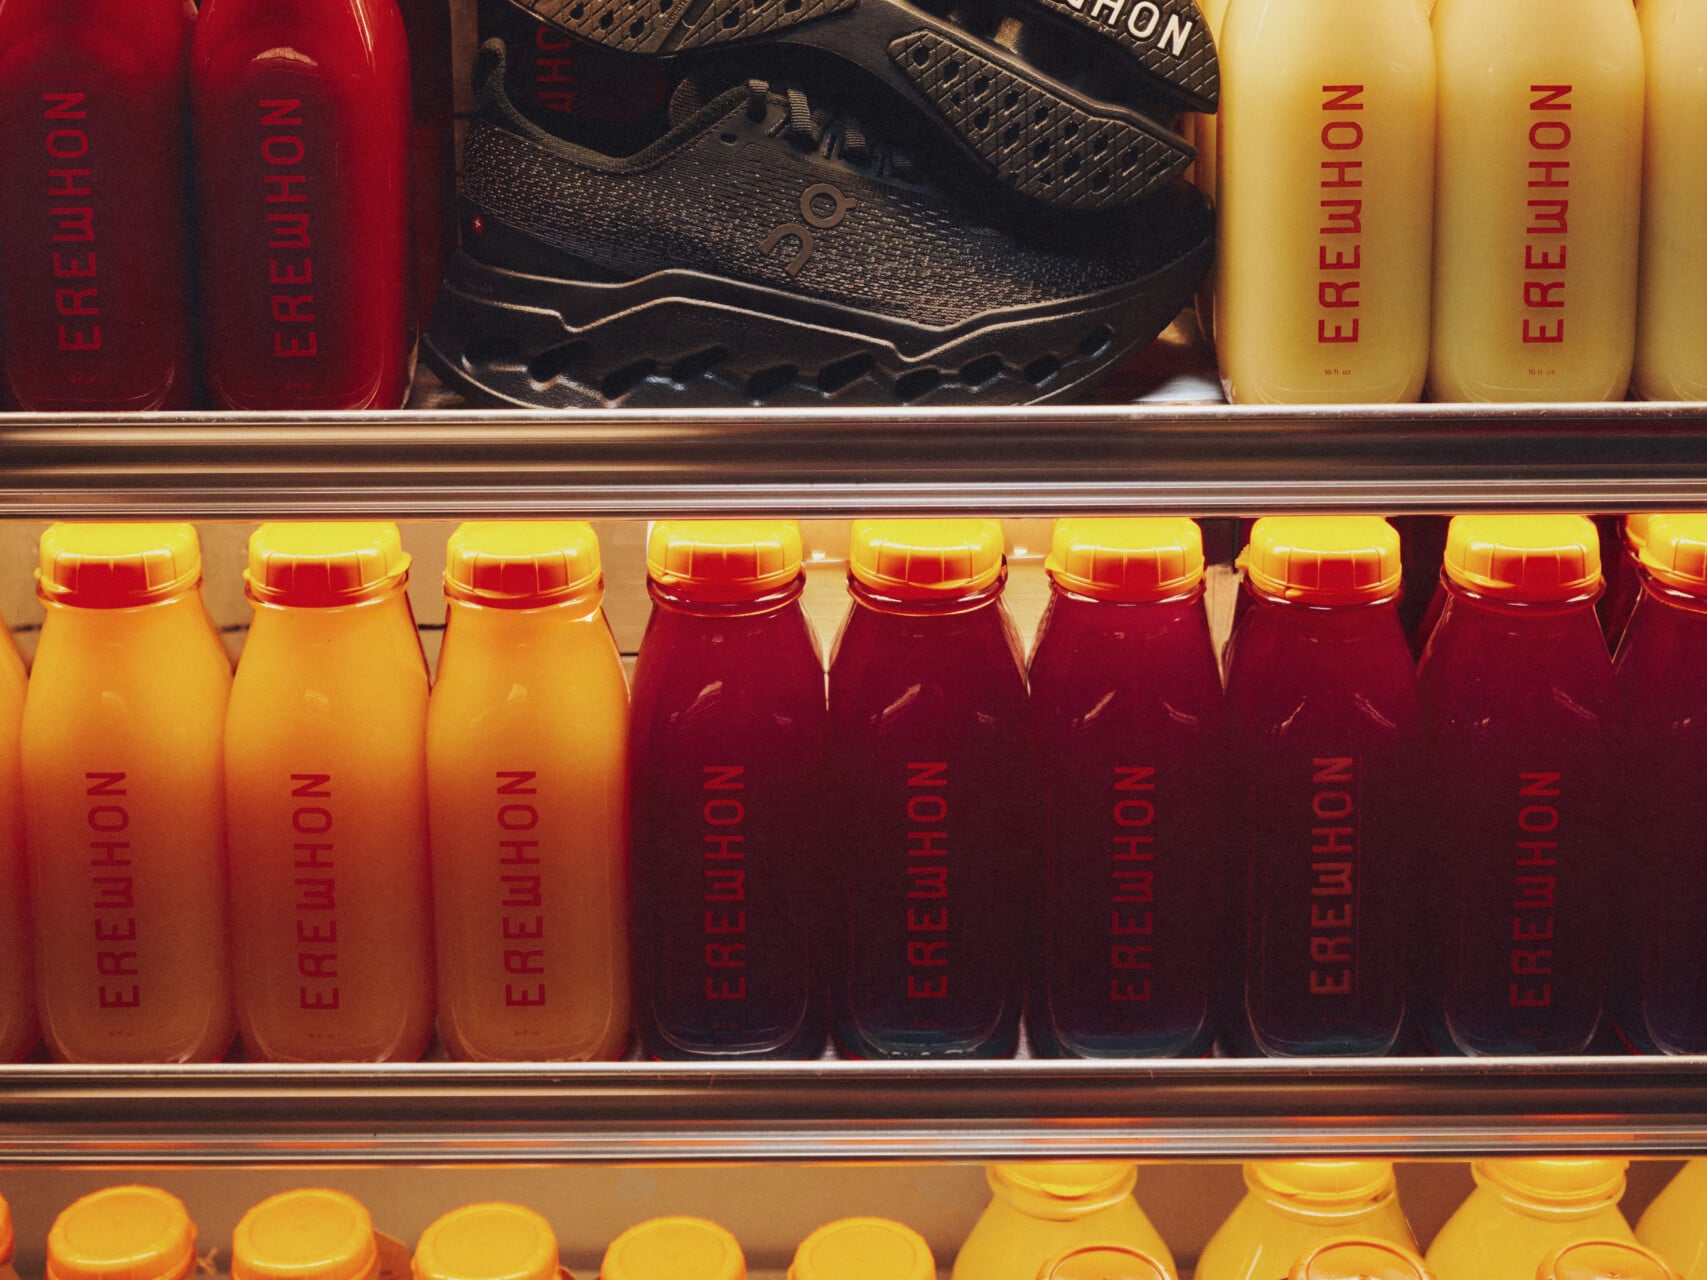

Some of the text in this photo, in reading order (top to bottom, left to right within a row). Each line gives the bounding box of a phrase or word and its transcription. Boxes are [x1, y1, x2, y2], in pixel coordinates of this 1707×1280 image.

[43, 92, 101, 351] EREWHON
[259, 99, 317, 357] EREWHON
[1318, 85, 1364, 343] EREWHON
[1522, 85, 1572, 343] EREWHON
[85, 771, 140, 1008] EREWHON
[290, 773, 339, 1010] EREWHON
[496, 771, 546, 1007] EREWHON
[703, 765, 746, 1000] EREWHON
[907, 761, 948, 999] EREWHON
[1110, 766, 1155, 1002] EREWHON
[1310, 756, 1353, 995] EREWHON
[1510, 771, 1561, 1008] EREWHON
